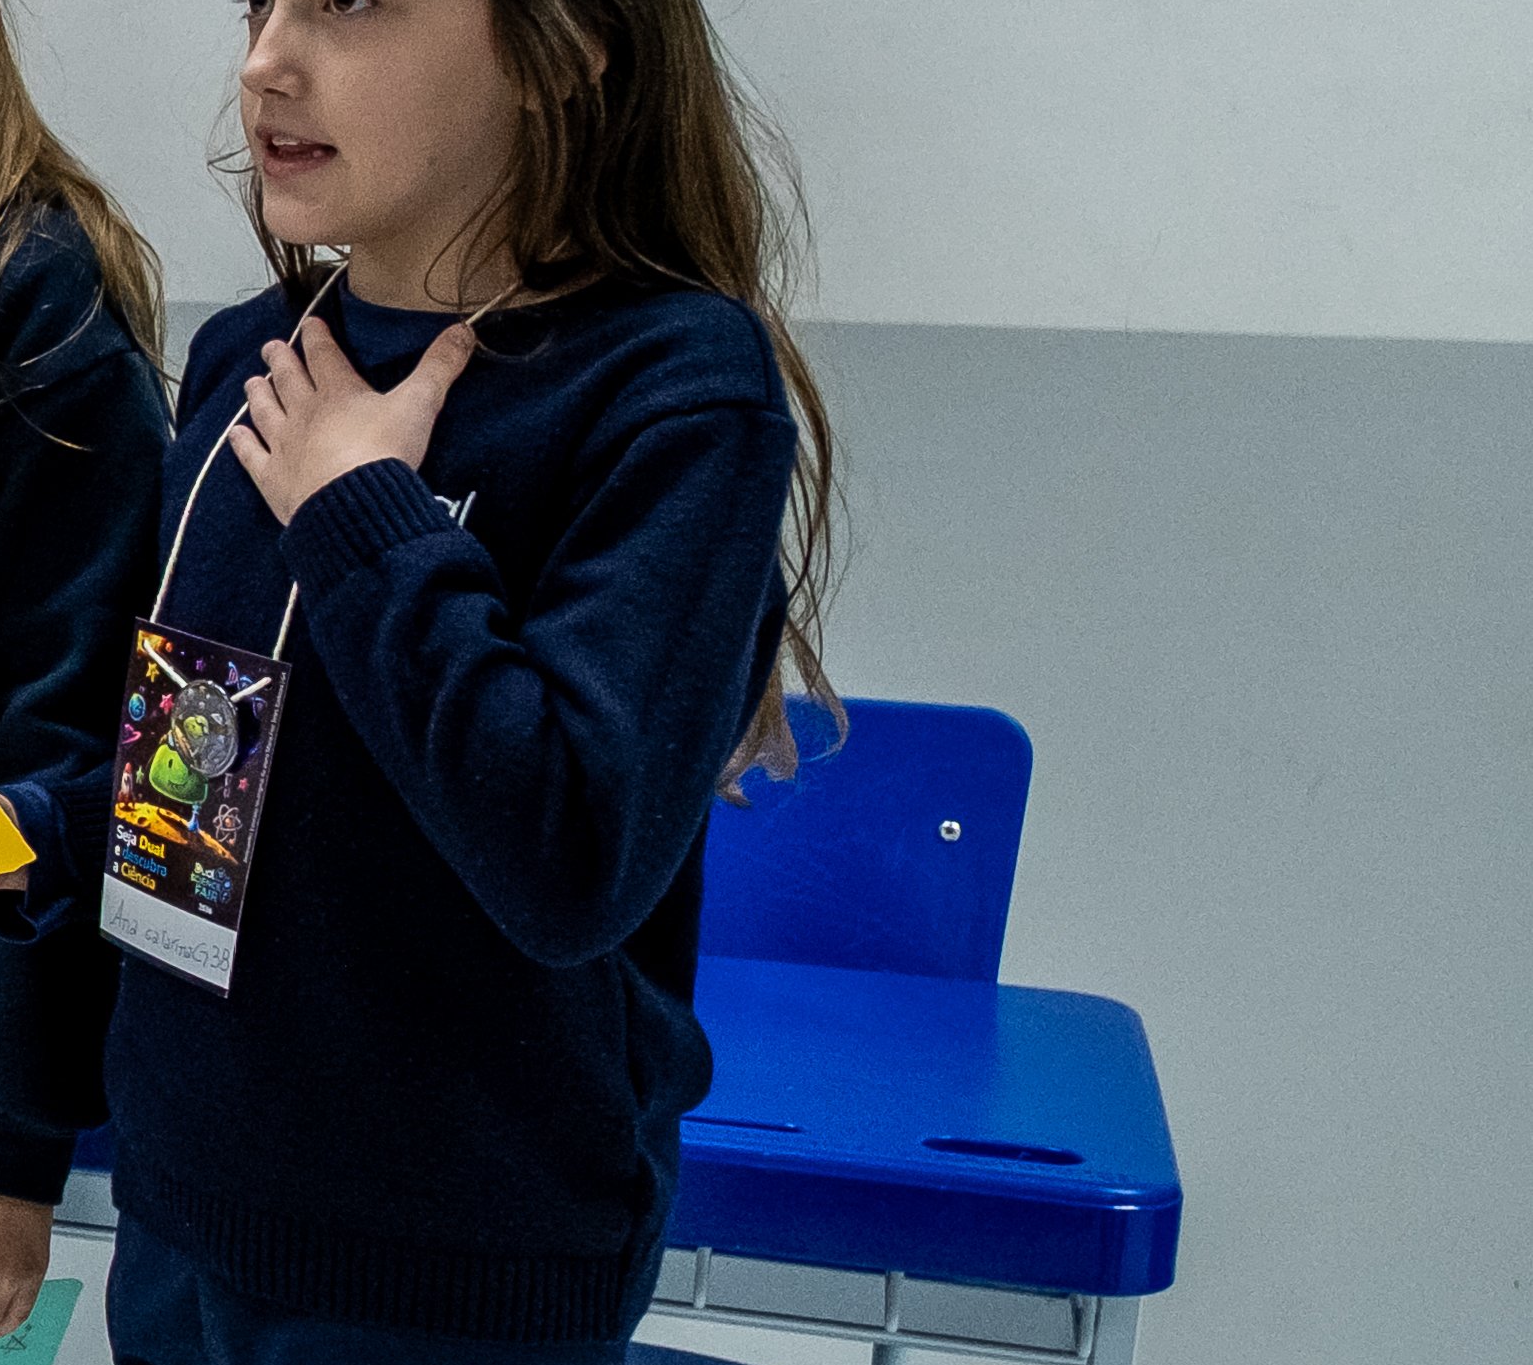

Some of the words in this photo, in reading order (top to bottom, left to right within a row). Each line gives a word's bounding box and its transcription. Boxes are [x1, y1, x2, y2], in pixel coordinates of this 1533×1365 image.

[116, 824, 138, 847] Seja
[139, 835, 165, 859] Dual
[113, 862, 119, 873] a
[121, 862, 156, 891] Ciência
[114, 844, 121, 855] e
[122, 847, 168, 877] descubra
